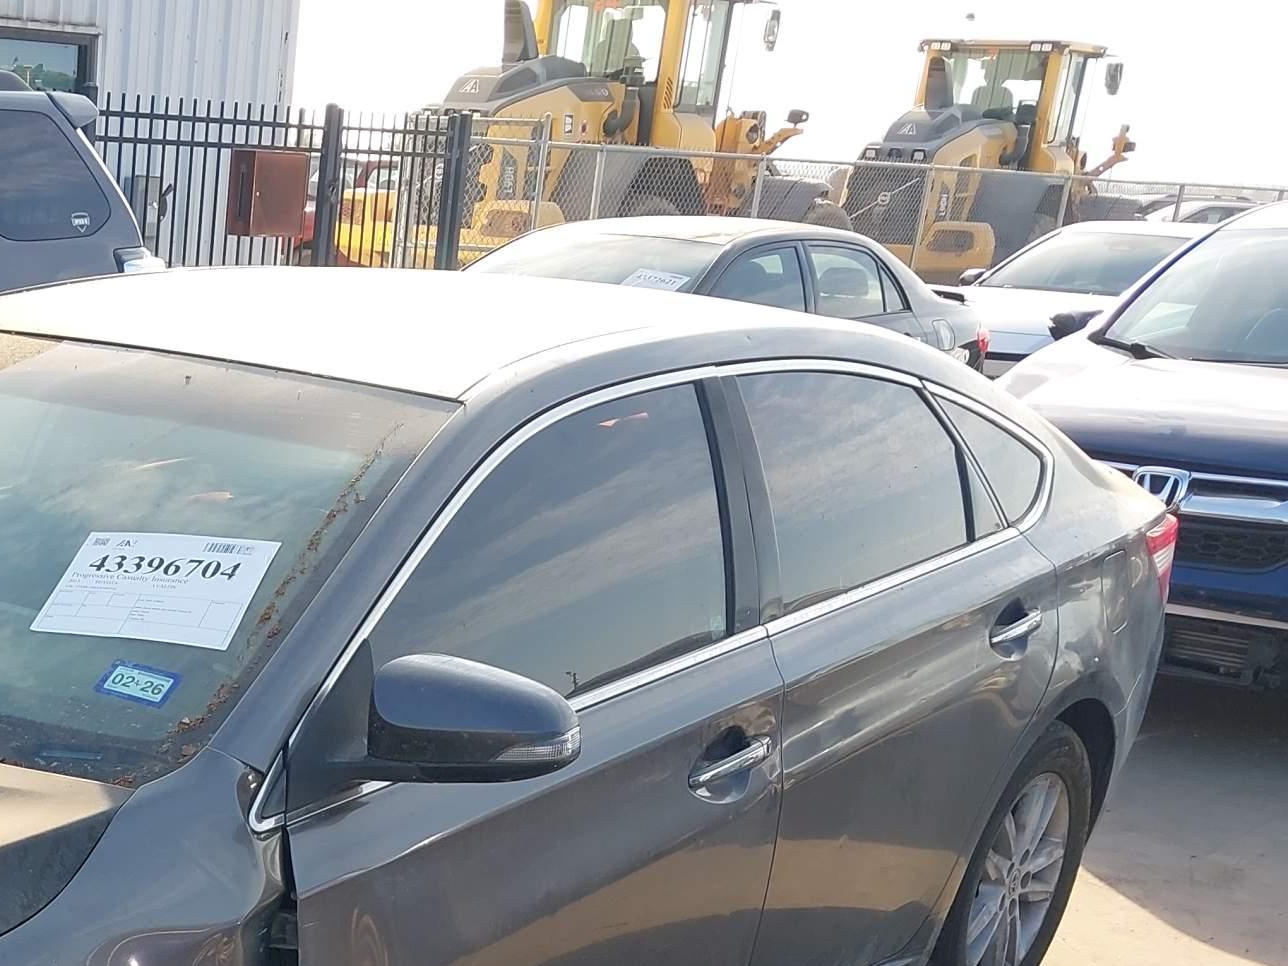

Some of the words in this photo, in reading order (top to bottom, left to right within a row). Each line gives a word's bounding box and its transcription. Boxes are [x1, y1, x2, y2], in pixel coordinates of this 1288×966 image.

[89, 554, 242, 581] 43396704
[72, 571, 114, 581] Progressive
[116, 573, 149, 583] Casualty
[151, 575, 189, 585] Insurance
